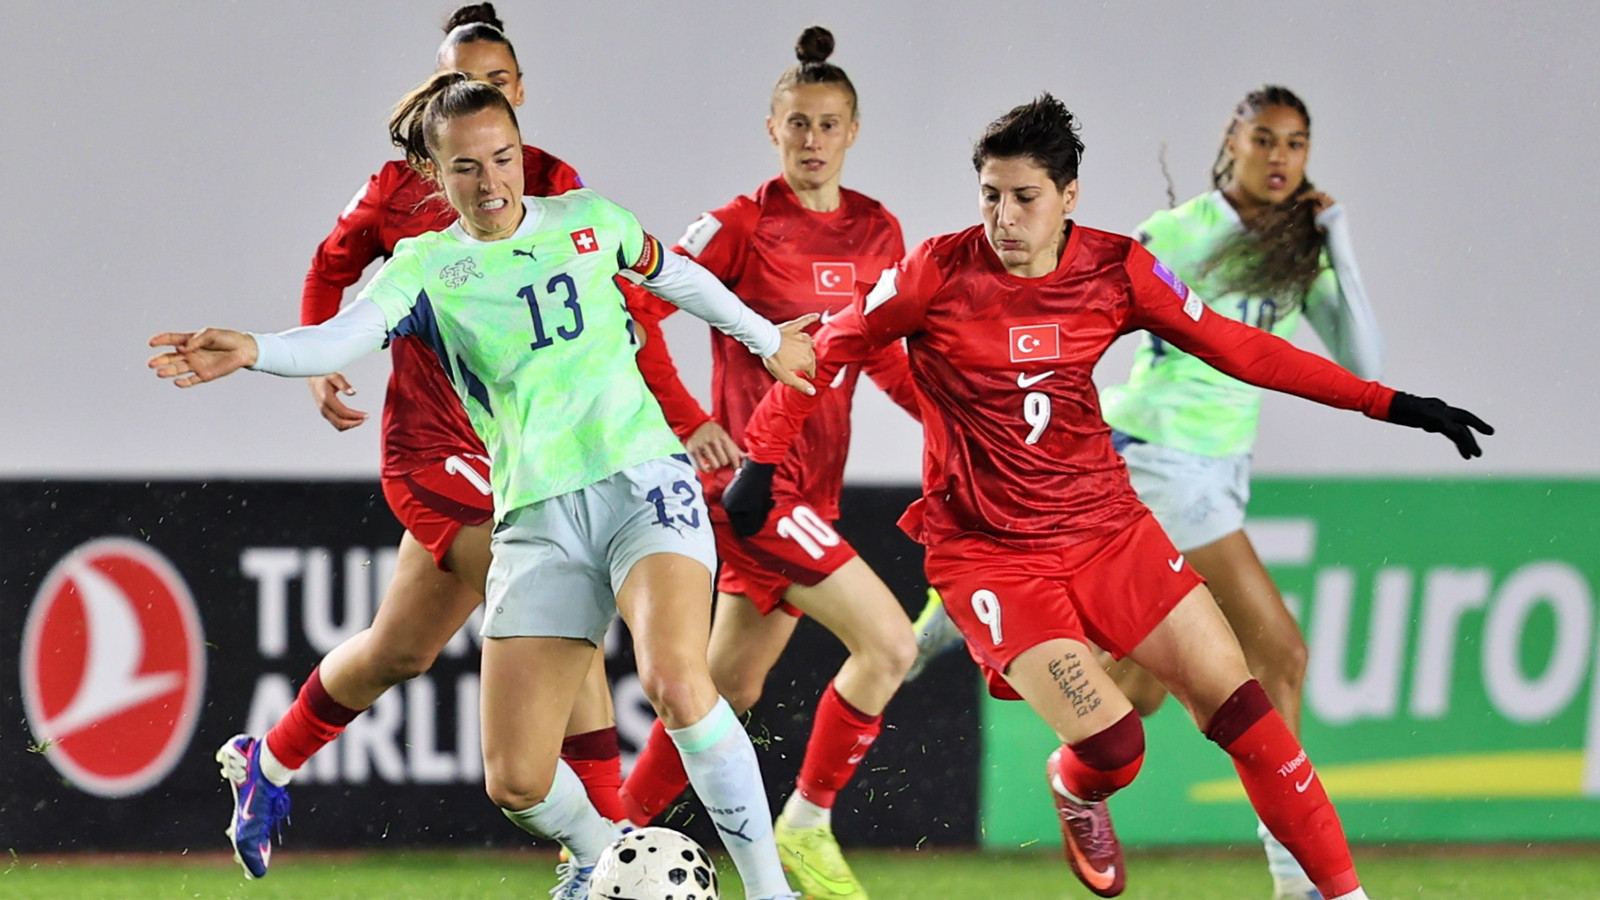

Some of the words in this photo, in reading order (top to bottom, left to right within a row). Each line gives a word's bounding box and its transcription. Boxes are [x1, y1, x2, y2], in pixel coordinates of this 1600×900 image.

[516, 272, 584, 351] 13
[1023, 391, 1051, 445] 9
[645, 480, 700, 528] 13
[776, 505, 840, 560] 10
[971, 588, 1003, 646] 9
